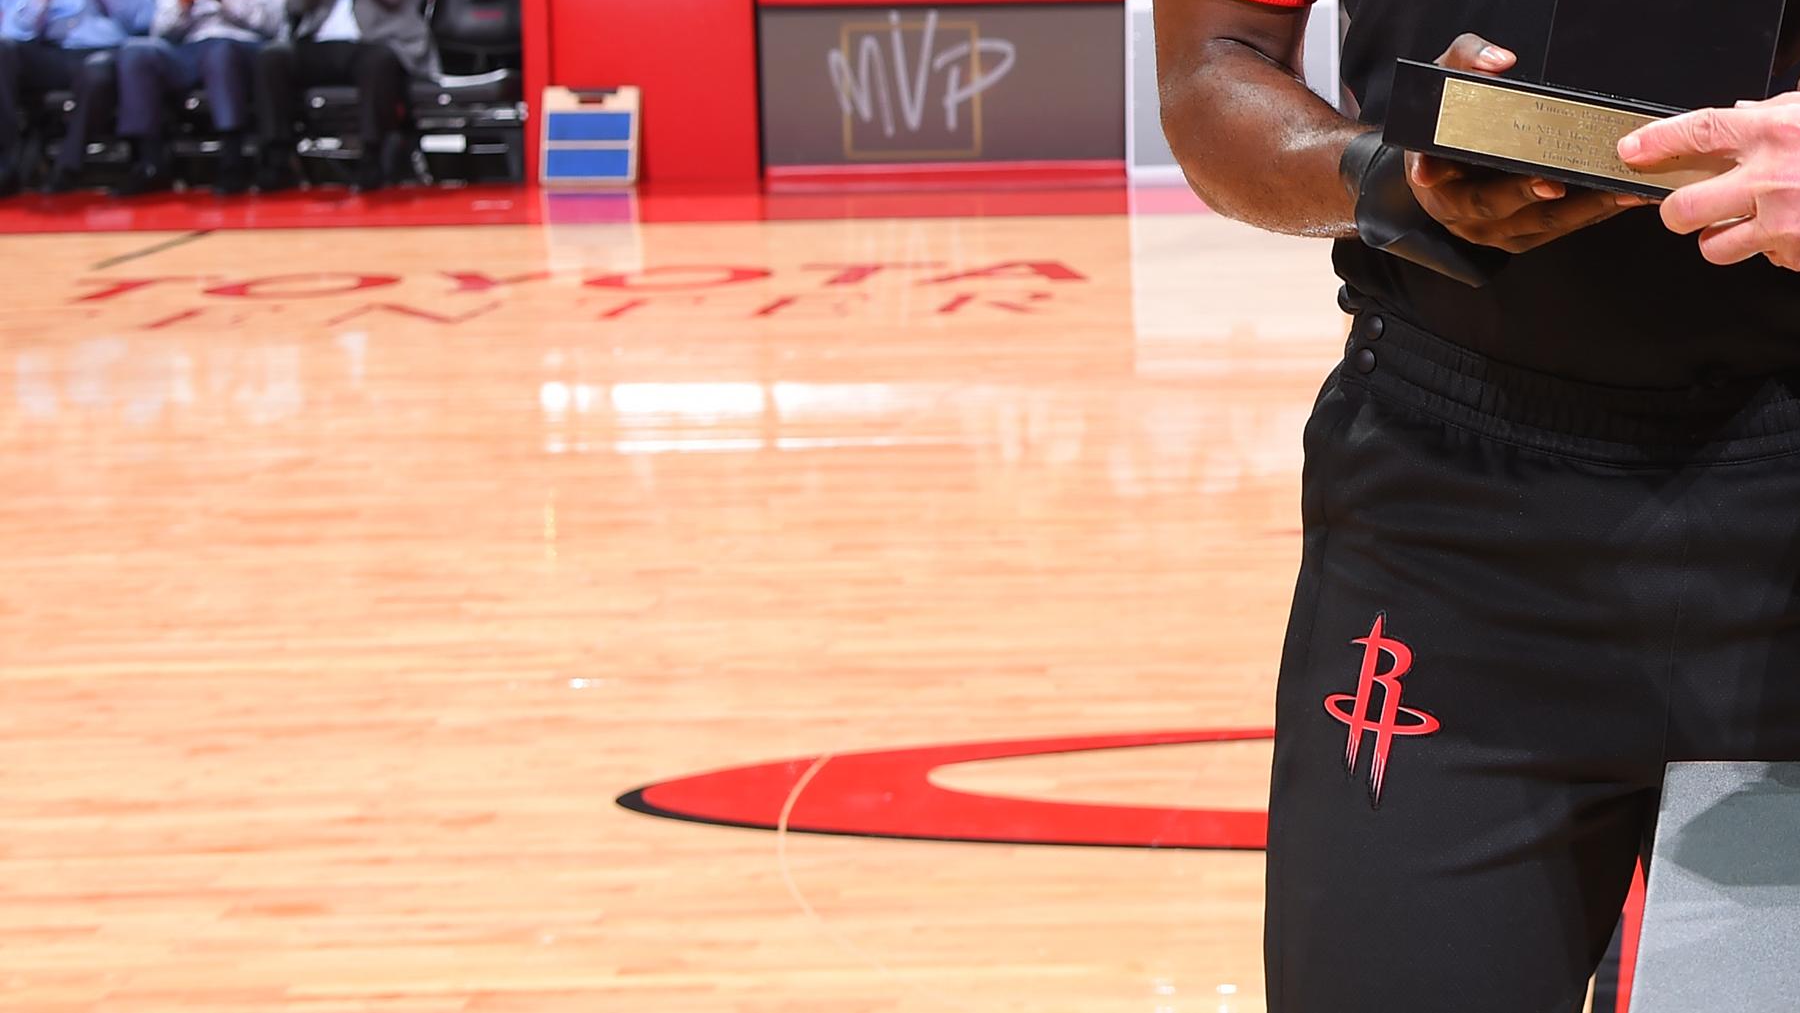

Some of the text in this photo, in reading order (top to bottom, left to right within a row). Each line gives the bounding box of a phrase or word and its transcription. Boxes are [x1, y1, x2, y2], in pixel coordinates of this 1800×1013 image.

[827, 9, 1016, 137] MVP
[63, 260, 1090, 306] TOYOTA
[62, 289, 1054, 329] ENTER
